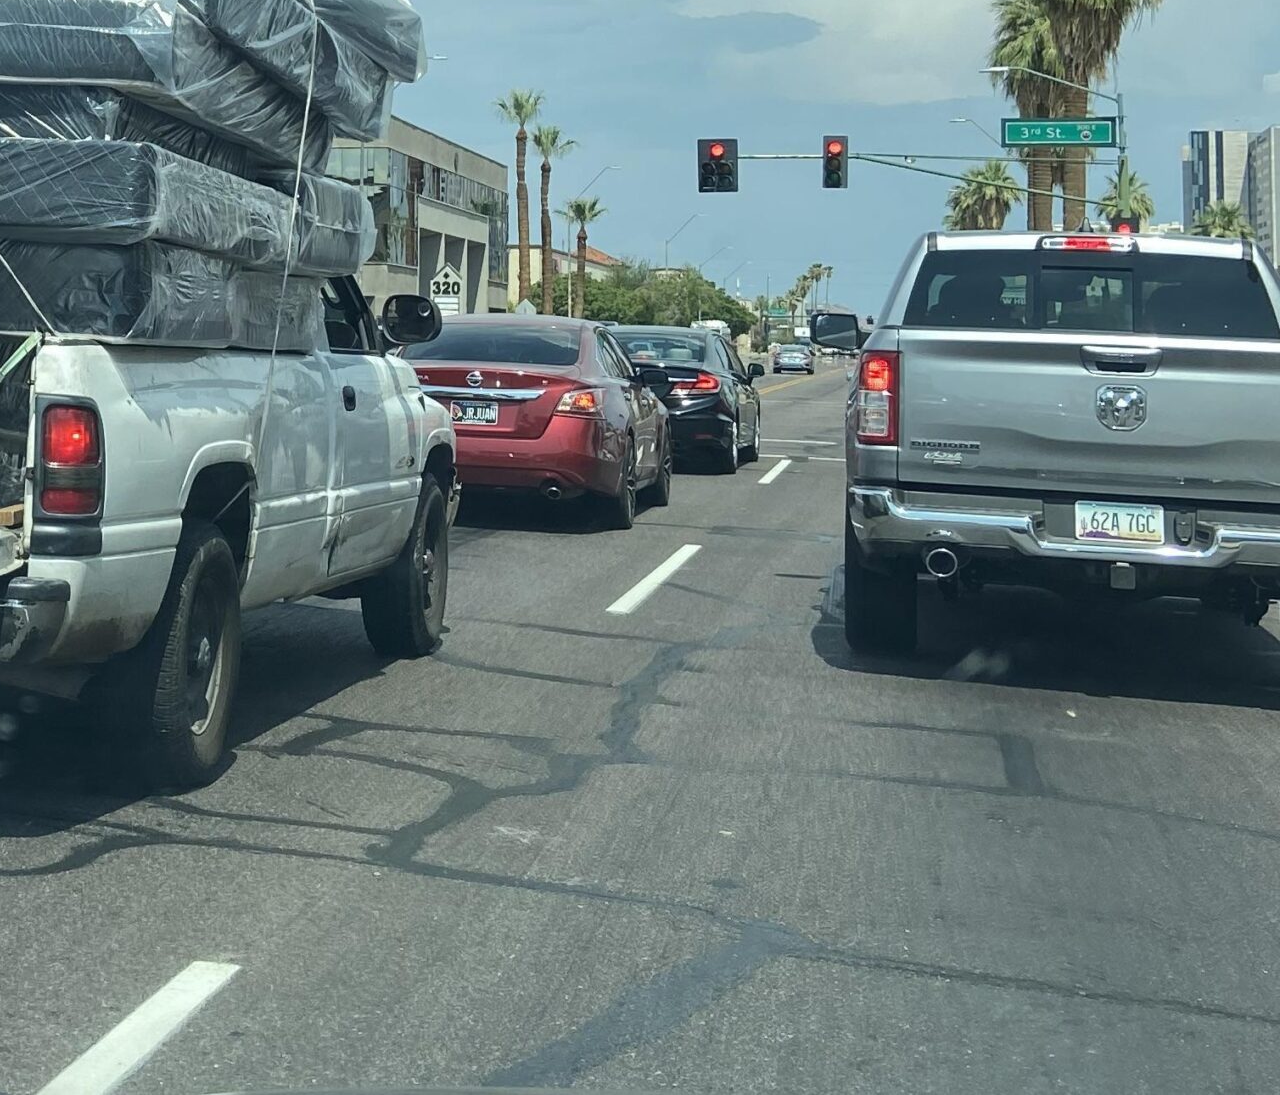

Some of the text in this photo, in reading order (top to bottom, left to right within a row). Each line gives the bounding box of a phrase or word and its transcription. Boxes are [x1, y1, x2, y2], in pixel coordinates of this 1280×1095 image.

[1020, 127, 1066, 139] 3rd St.
[432, 281, 461, 295] 320
[462, 407, 496, 421] JRJUAN
[1091, 511, 1156, 534] 62A 7GC
